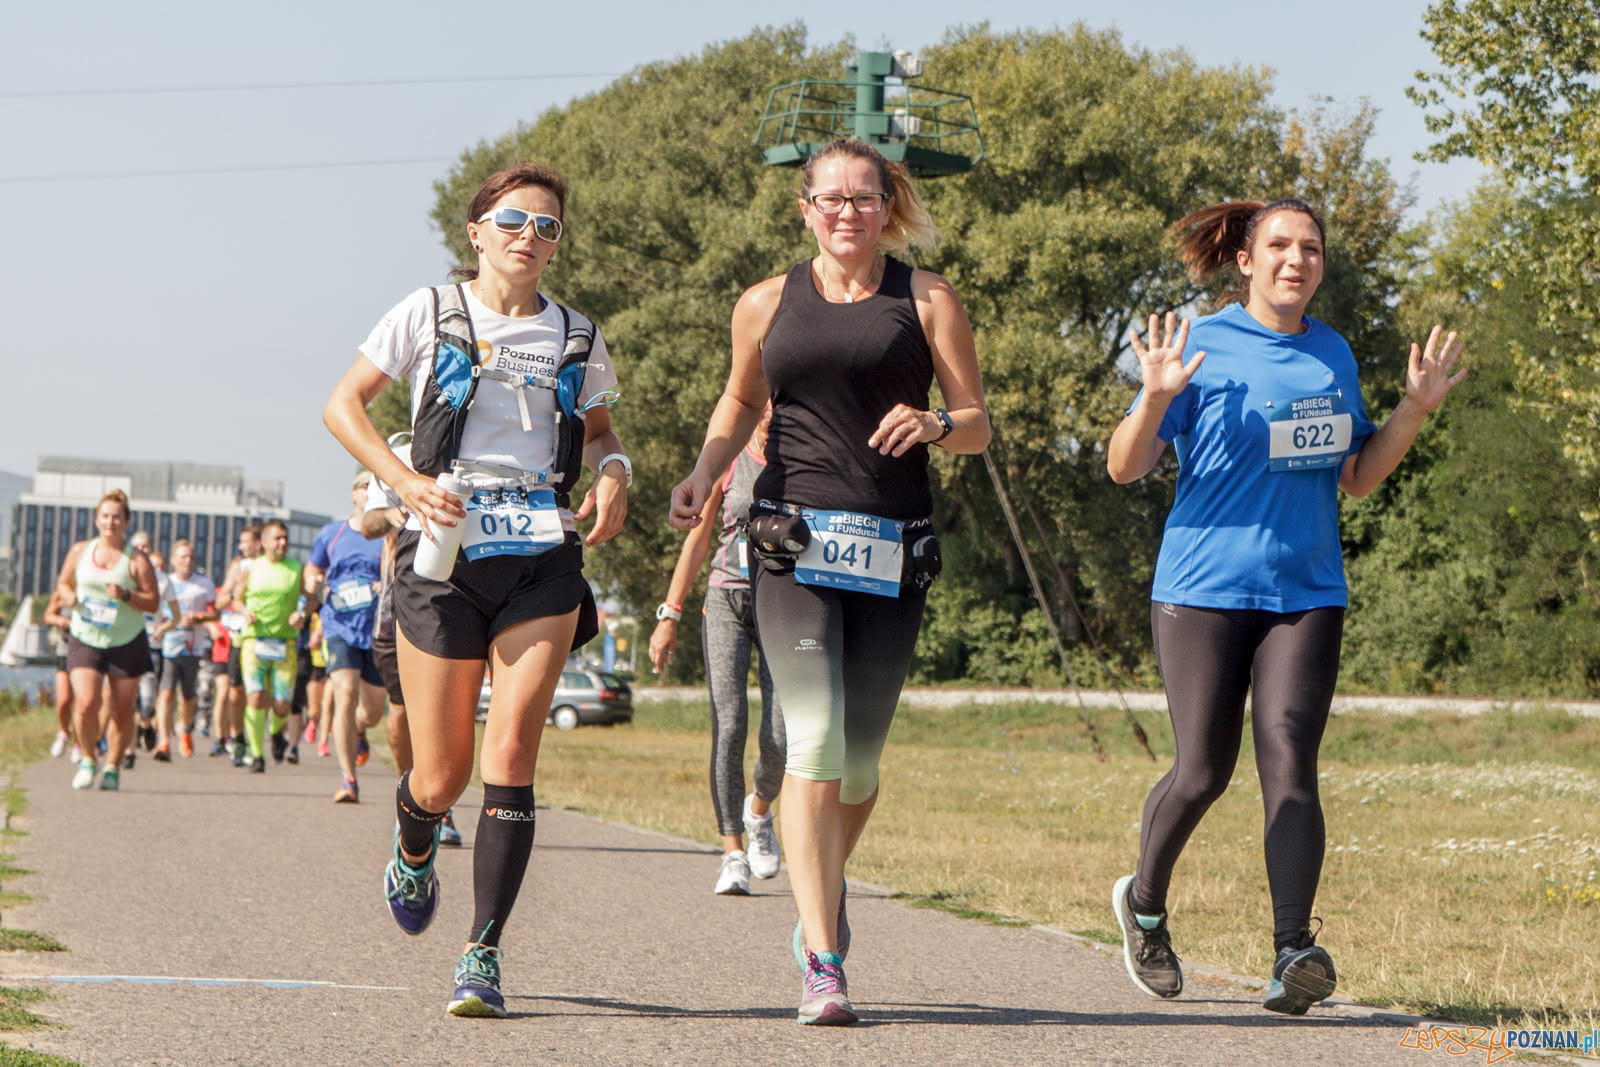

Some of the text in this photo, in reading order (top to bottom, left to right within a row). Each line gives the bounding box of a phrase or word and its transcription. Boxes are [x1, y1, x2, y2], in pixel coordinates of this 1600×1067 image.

[500, 346, 555, 365] Poznań
[1291, 397, 1332, 411] zaBIEGaj
[1292, 422, 1335, 450] 622
[480, 513, 535, 536] 012
[828, 513, 881, 532] zaBIEGaj
[828, 524, 835, 532] o
[822, 539, 873, 570] 041
